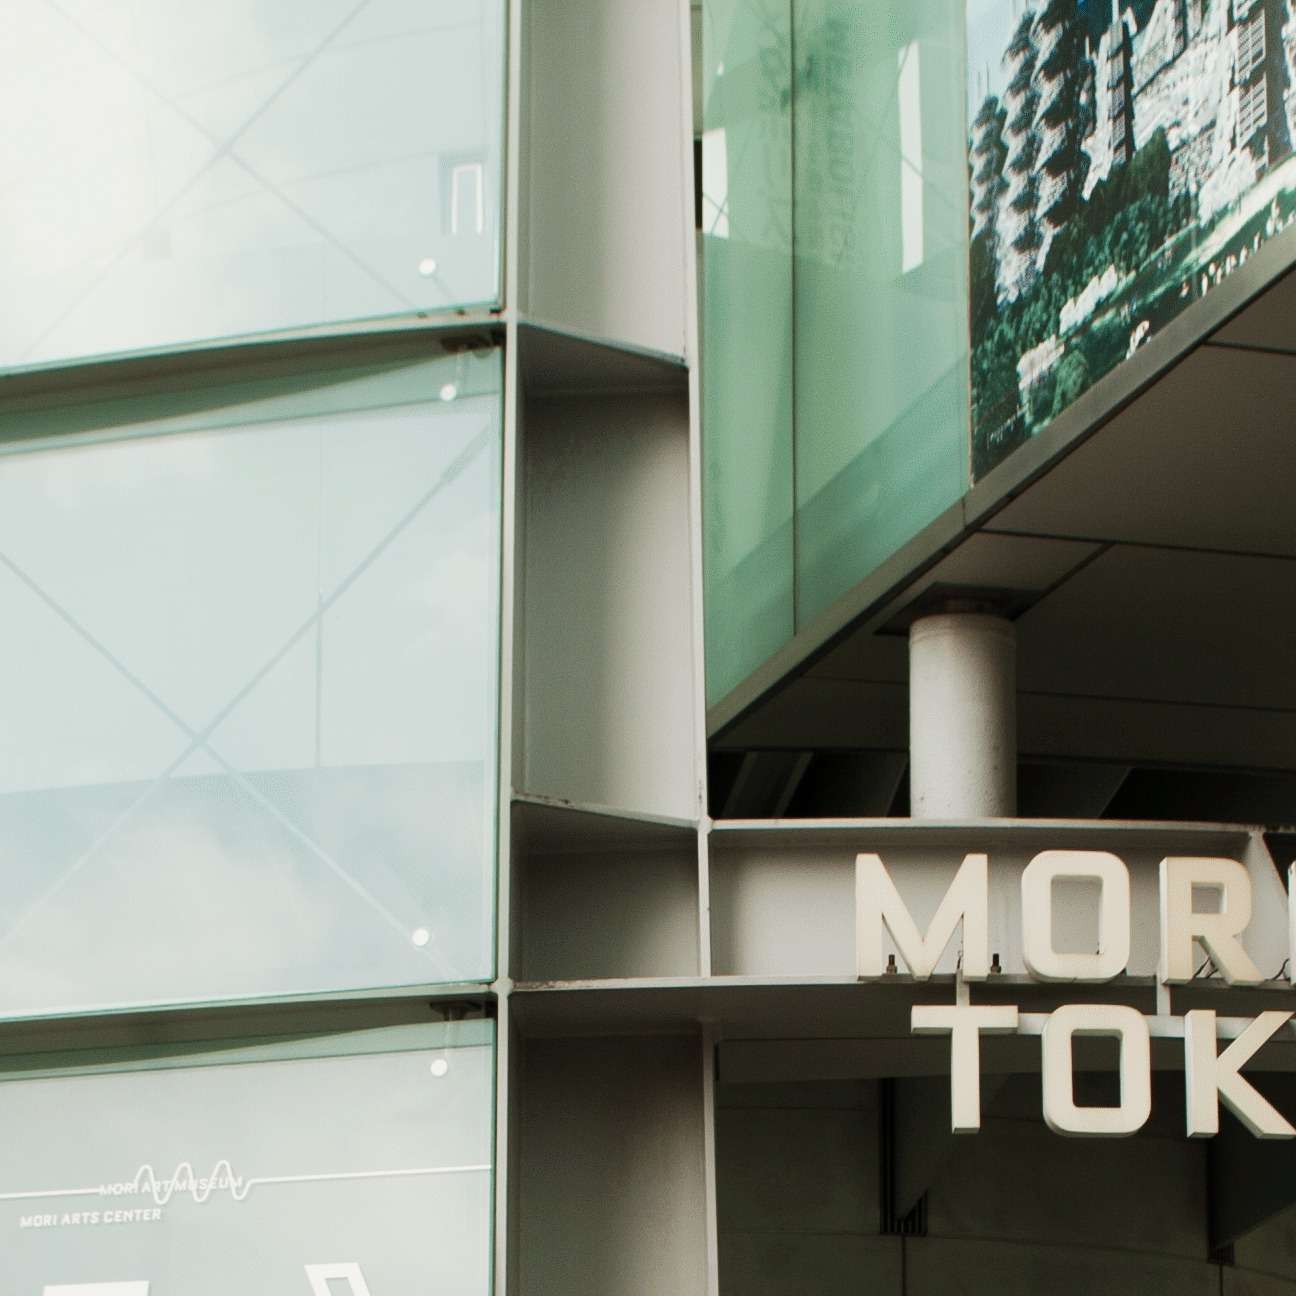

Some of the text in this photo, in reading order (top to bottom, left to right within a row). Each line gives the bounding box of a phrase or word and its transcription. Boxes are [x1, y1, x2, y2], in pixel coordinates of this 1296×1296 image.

[20, 1208, 161, 1228] MORI ARTS CENTER
